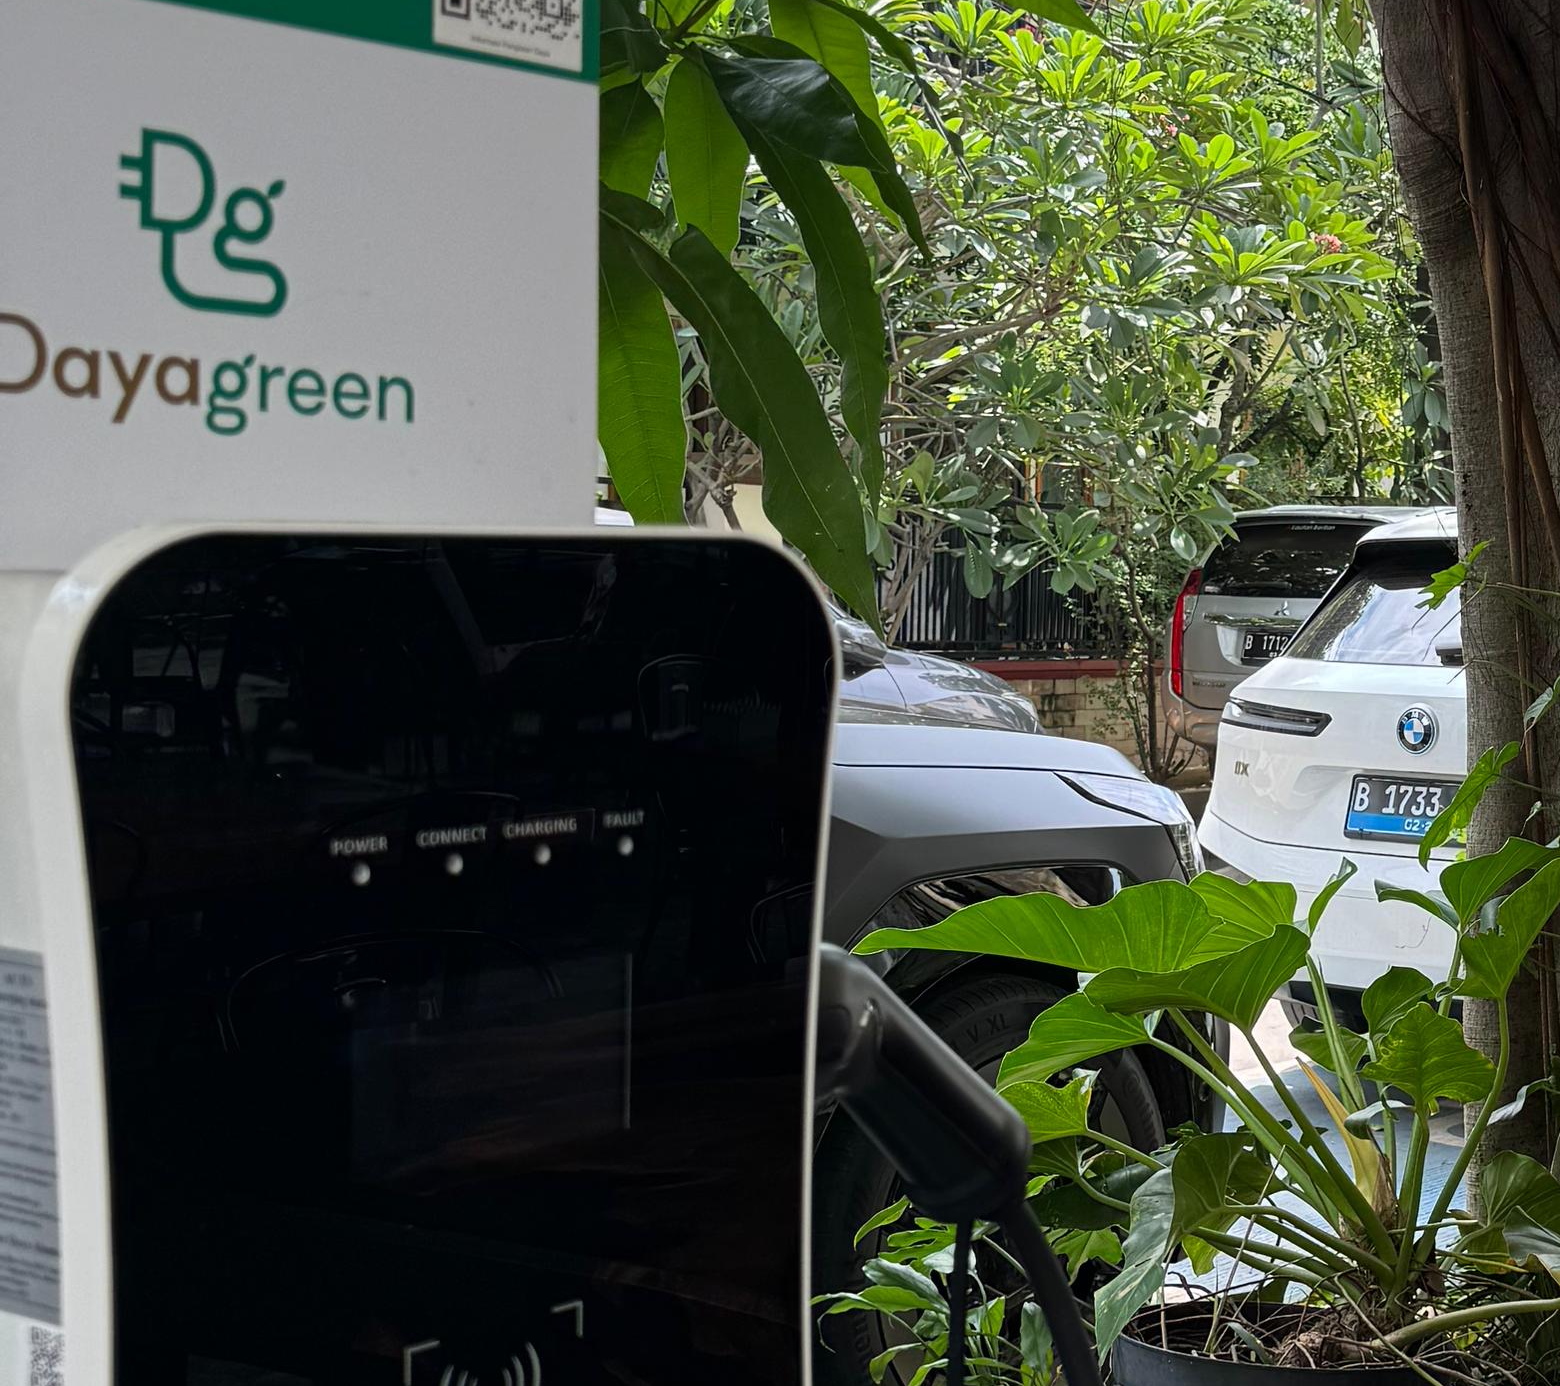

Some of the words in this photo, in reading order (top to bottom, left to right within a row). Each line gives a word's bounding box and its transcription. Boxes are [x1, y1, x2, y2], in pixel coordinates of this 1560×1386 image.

[0, 312, 415, 436] Dayagreen
[1245, 635, 1253, 650] B
[1263, 635, 1289, 651] 1712
[1401, 710, 1430, 725] BMW
[1353, 782, 1371, 812] B
[1382, 784, 1442, 817] 1733
[331, 836, 389, 856] POWER
[417, 826, 488, 847] CONNECT
[504, 817, 578, 839] CHARGING
[604, 810, 645, 828] FAULT
